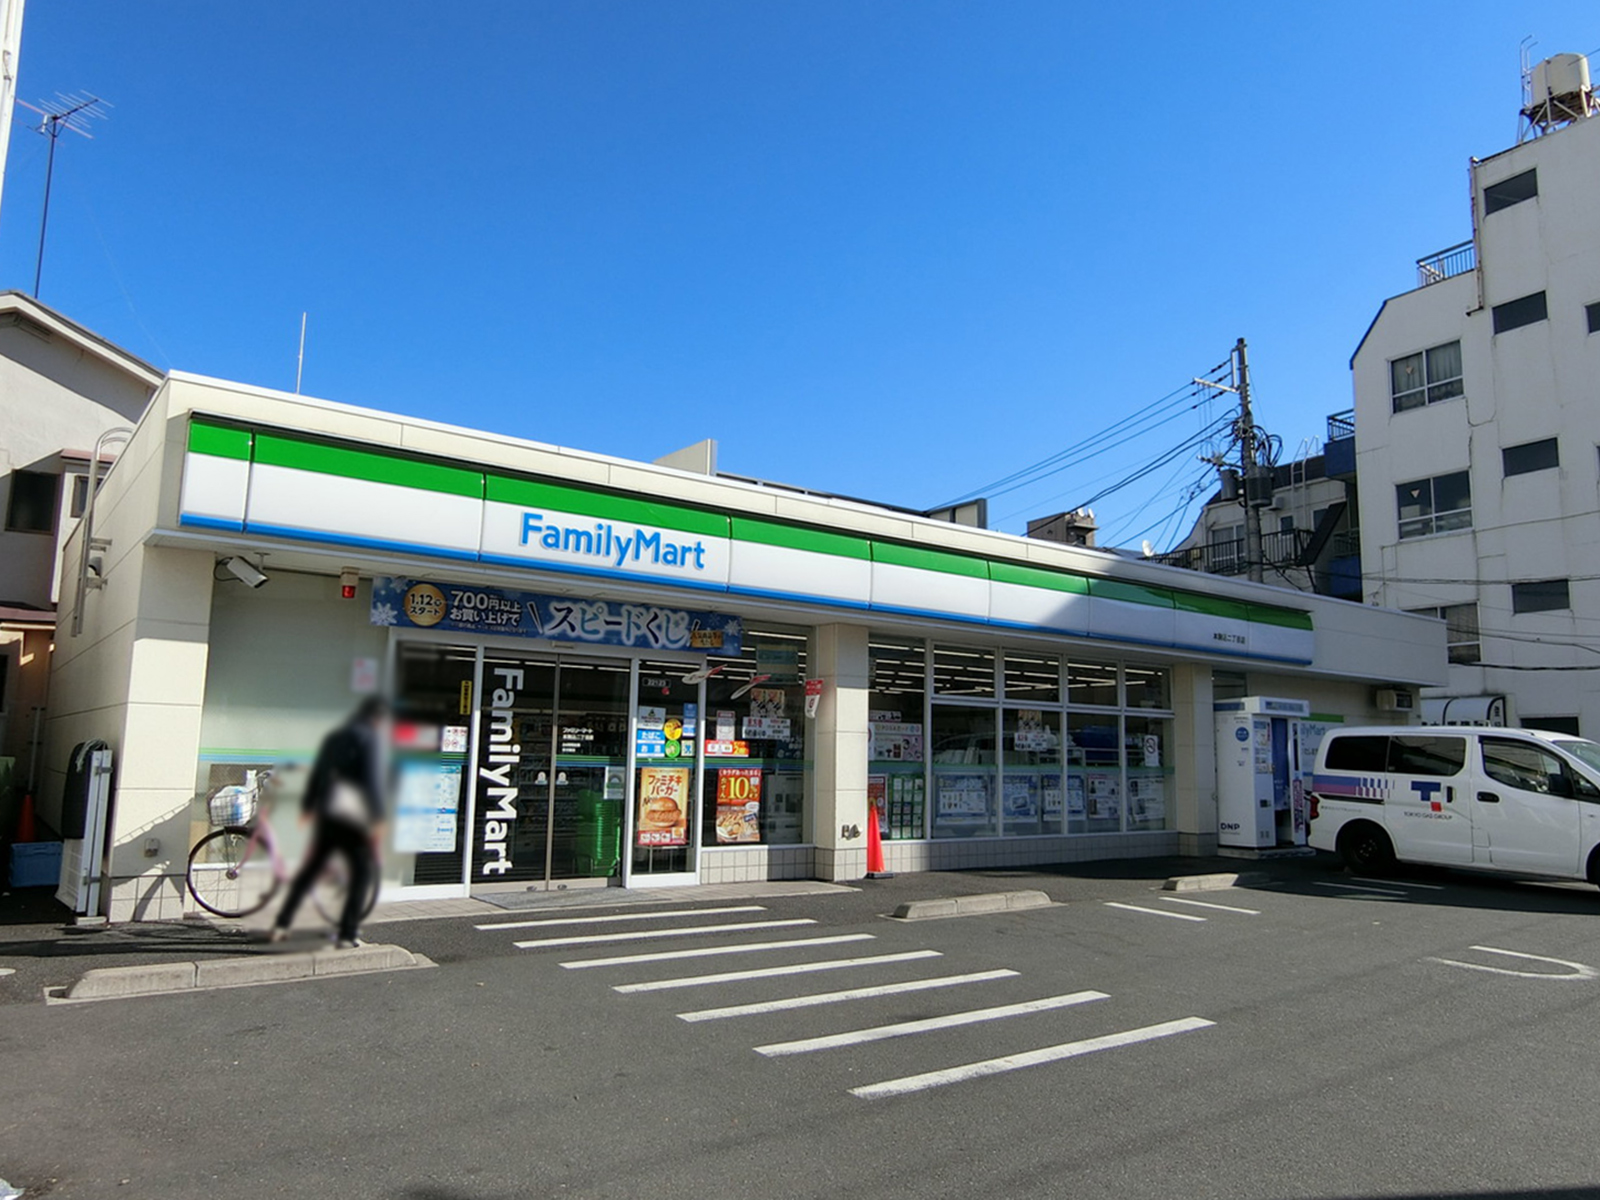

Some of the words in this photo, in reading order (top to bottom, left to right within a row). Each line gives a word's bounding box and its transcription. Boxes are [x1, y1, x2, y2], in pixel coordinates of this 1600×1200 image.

[521, 512, 706, 570] FamilyMart
[451, 590, 523, 613] 700円以上
[410, 606, 441, 617] スタート
[450, 607, 520, 626] お買い上げで
[546, 605, 687, 647] スピードくじ
[642, 730, 662, 740] たばこ
[480, 667, 524, 876] FamilyMart
[648, 774, 682, 787] ファミチキ
[728, 776, 750, 800] 10
[651, 784, 678, 796] バーガー
[1433, 813, 1453, 821] GROUP
[1220, 822, 1240, 831] DNP
